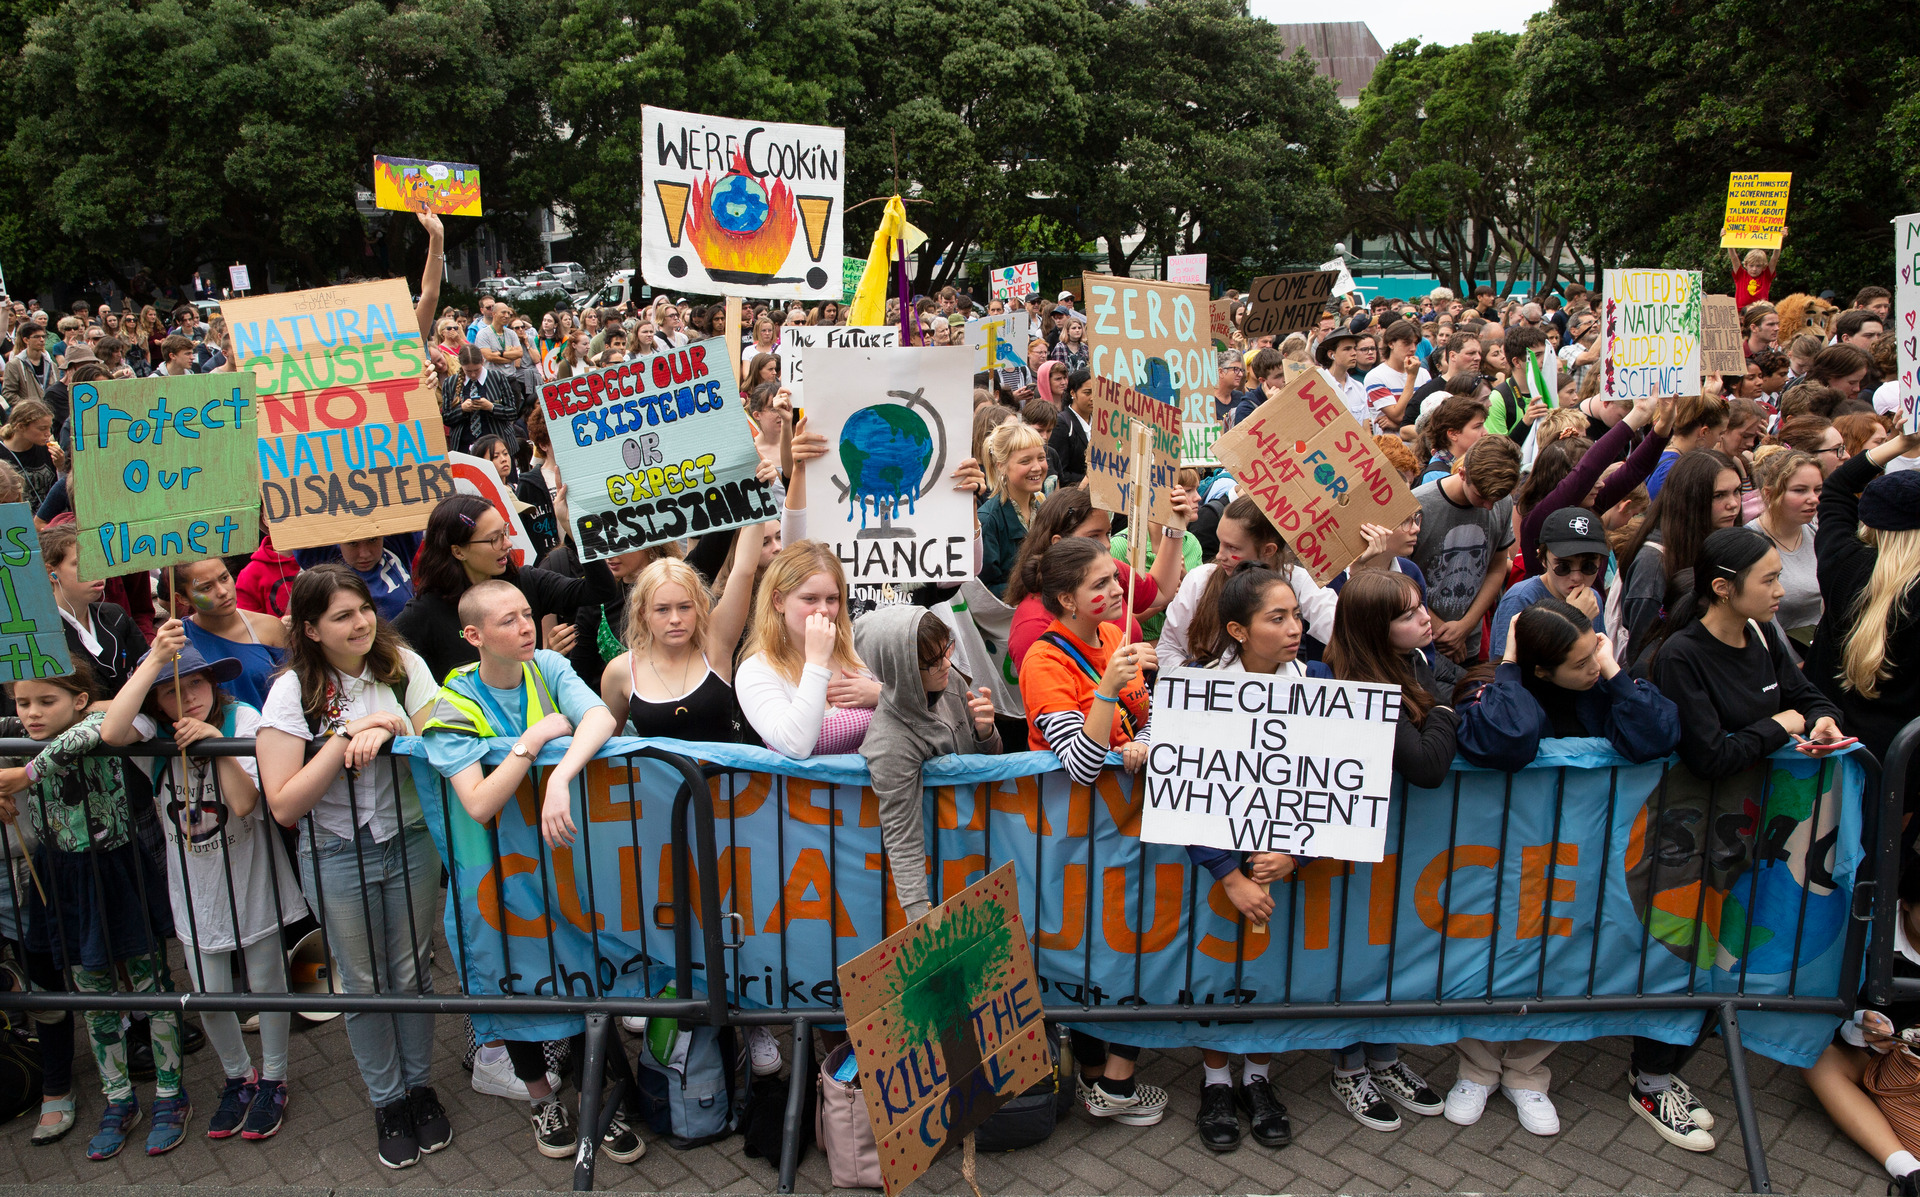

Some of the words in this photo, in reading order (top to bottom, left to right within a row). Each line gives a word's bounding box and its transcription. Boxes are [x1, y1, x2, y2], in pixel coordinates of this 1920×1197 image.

[1740, 190, 1788, 198] GOVERNMENTS
[1762, 208, 1785, 216] ABOUT
[1749, 224, 1760, 232] YOU
[1759, 216, 1784, 224] ACTION
[992, 262, 1037, 282] LOVE
[992, 282, 1031, 300] MOTHER
[1172, 274, 1200, 282] FUTURE
[1258, 275, 1314, 303] COME
[1312, 273, 1341, 298] ON
[1612, 270, 1670, 304] UNITED
[1676, 273, 1694, 303] BY
[308, 300, 331, 310] DIE
[335, 297, 350, 306] OF
[310, 291, 336, 302] WANT
[1210, 312, 1226, 323] TING
[1624, 304, 1680, 334] NATURE
[234, 304, 420, 359] NATURAL
[785, 328, 816, 348] The
[827, 328, 895, 348] FUTURE
[1612, 335, 1668, 366] GUIDED
[1674, 335, 1694, 366] BY
[244, 338, 422, 396] CAUSES
[542, 361, 646, 420] RESPECT
[652, 345, 709, 389] OUR
[1618, 366, 1684, 398] SCIENCE
[72, 383, 250, 450] Protect
[263, 378, 420, 434] NOT
[572, 380, 724, 447] EXISTENCE
[1098, 375, 1122, 406] THE
[1124, 388, 1182, 435] CLIMATE
[258, 420, 444, 480] NATURAL
[622, 432, 663, 470] OR
[1098, 408, 1108, 435] IS
[1110, 410, 1180, 460] CHGING
[1298, 380, 1340, 428] WE
[1334, 430, 1393, 506] STAND
[123, 459, 202, 493] Our
[606, 453, 716, 506] EXPECT
[1091, 445, 1130, 479] WHY
[1248, 418, 1305, 483] WHAT
[1302, 496, 1340, 541] WE
[1303, 450, 1348, 499] FOR
[262, 463, 456, 523] DISASTERS
[98, 516, 239, 566] Planet
[576, 476, 778, 560] RESISTANCE
[1238, 460, 1301, 532] STAND
[1296, 532, 1332, 579] ON!
[834, 536, 968, 579] HANGE
[1160, 676, 1235, 712] THE
[1238, 680, 1402, 723] CLIMATE
[1250, 718, 1287, 751] IS
[1150, 742, 1364, 791] CHANGING
[1148, 776, 1245, 816] WHY
[1243, 786, 1388, 828] AREN'T
[1228, 817, 1315, 855] WE?
[1030, 842, 1578, 963] JUSTICE
[875, 1038, 948, 1126] KILL
[968, 978, 1042, 1055] THE
[918, 1053, 1015, 1148] COAL
